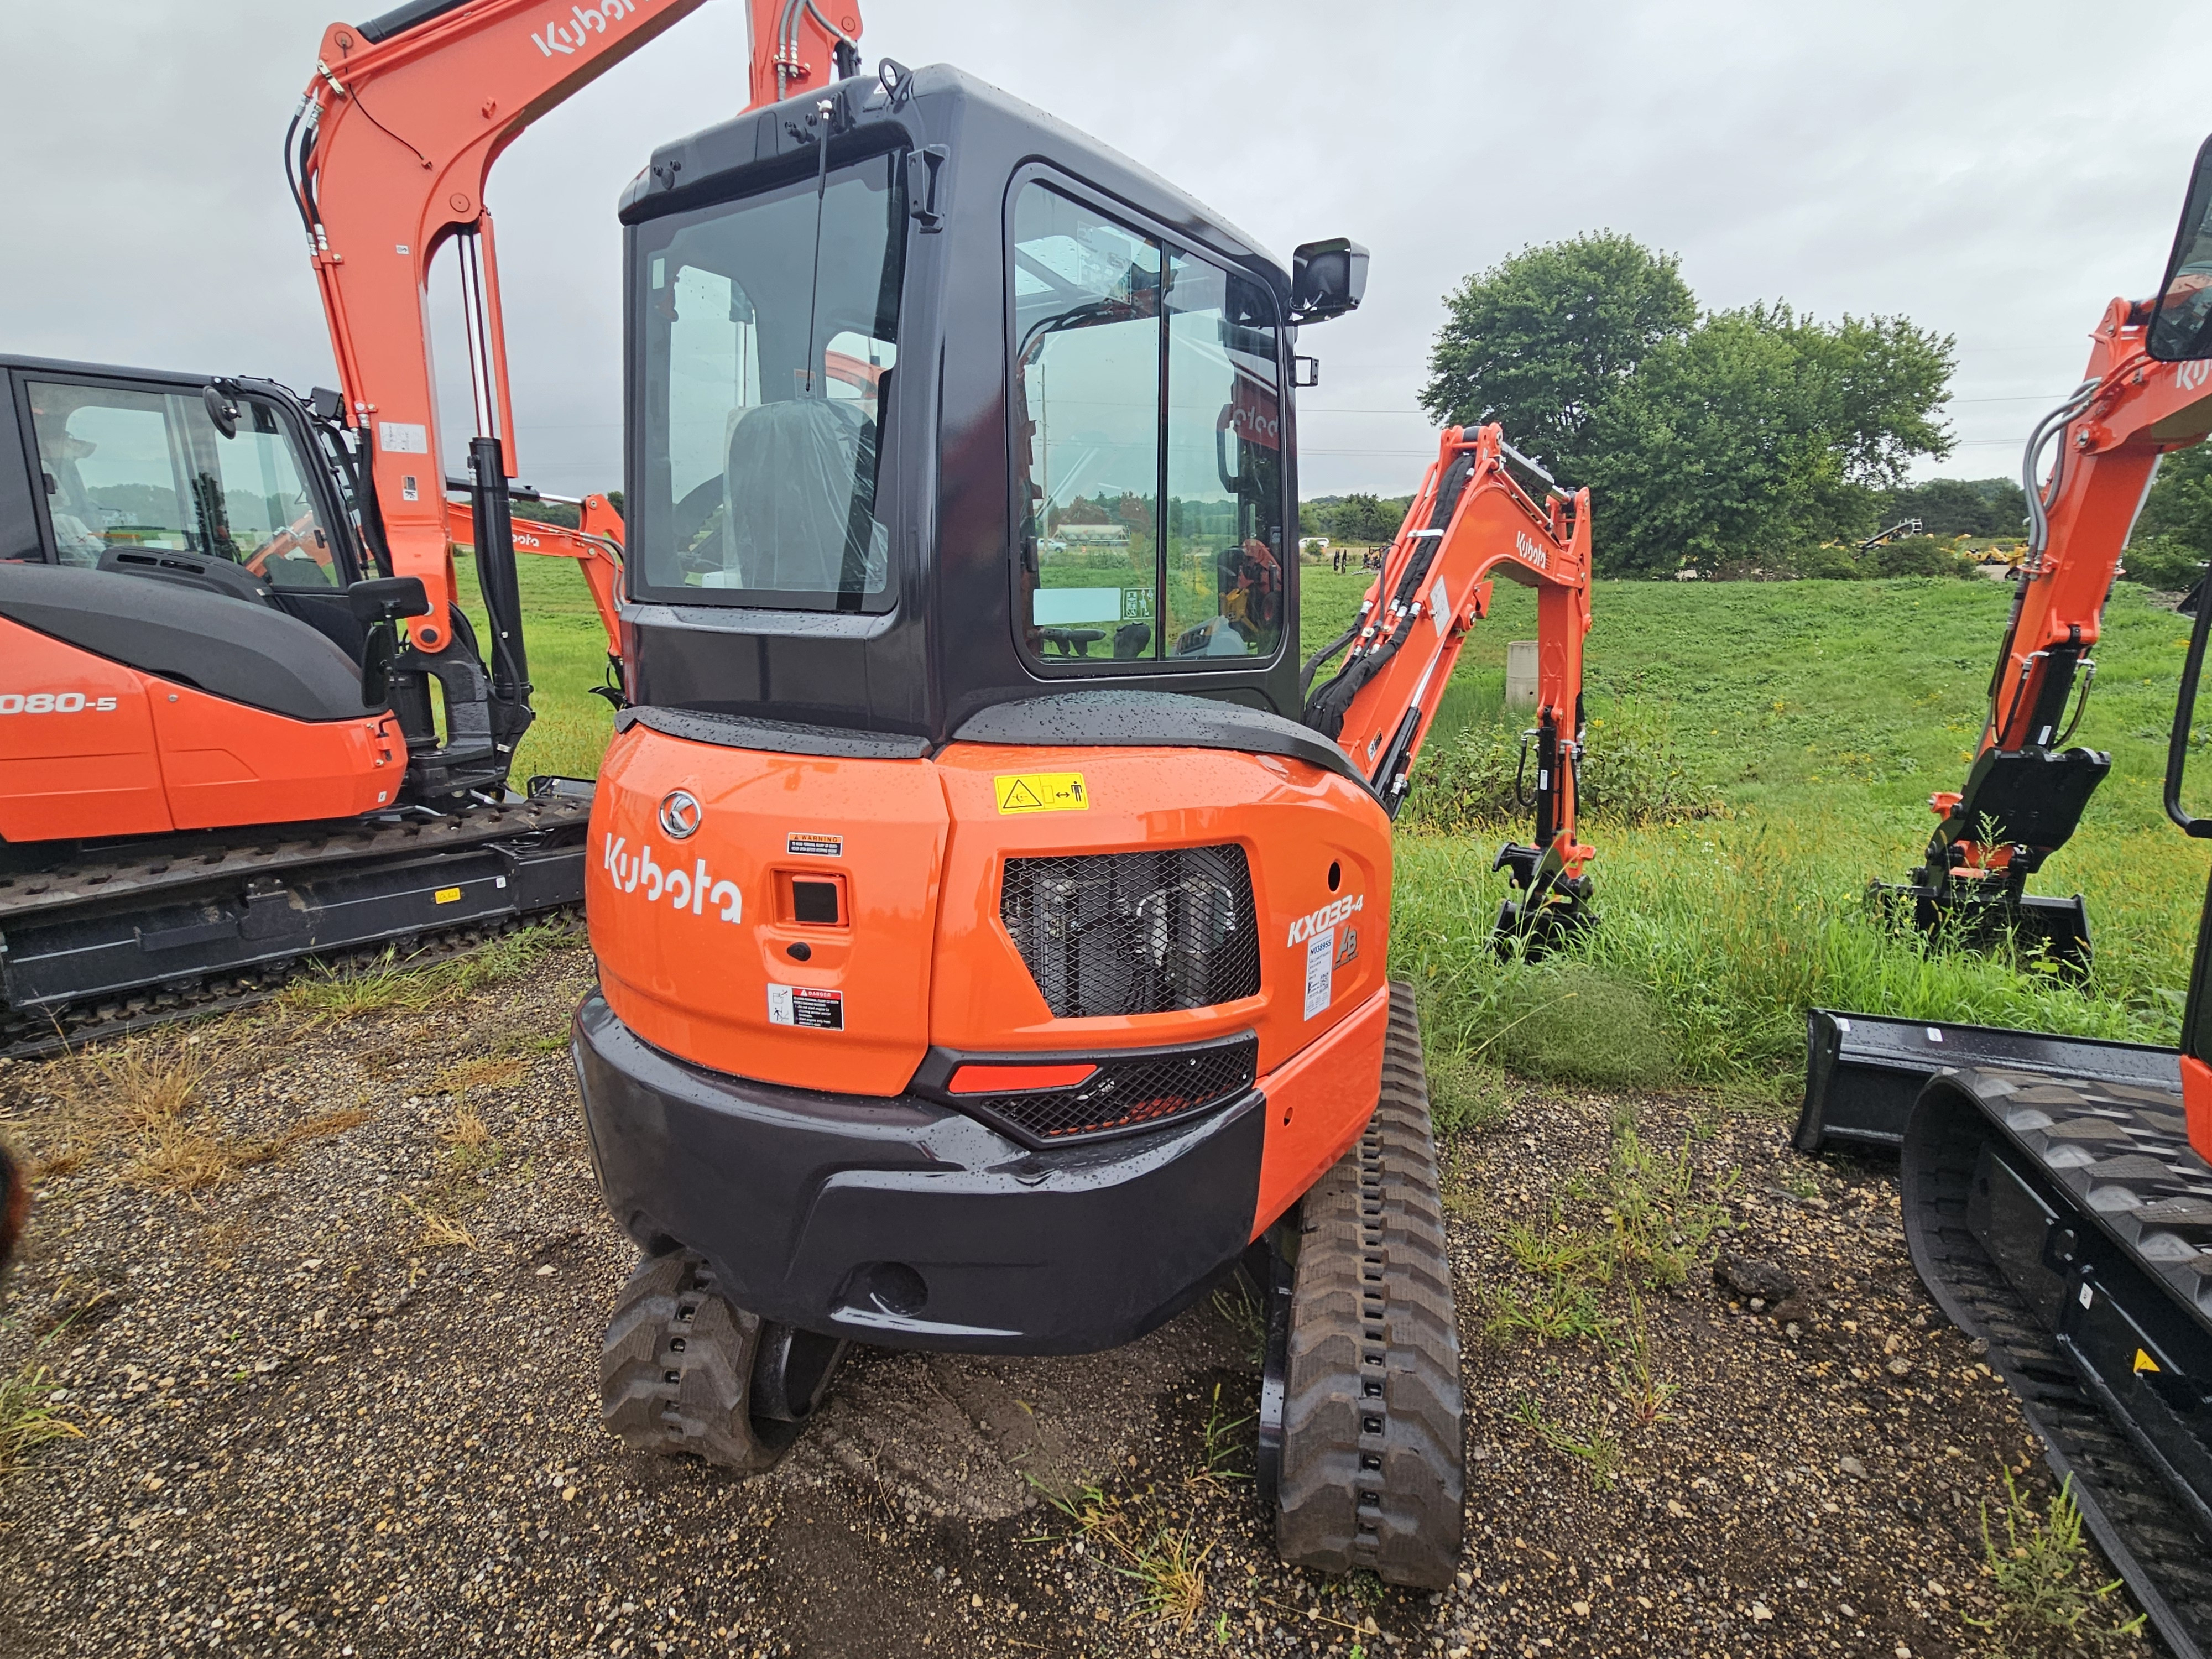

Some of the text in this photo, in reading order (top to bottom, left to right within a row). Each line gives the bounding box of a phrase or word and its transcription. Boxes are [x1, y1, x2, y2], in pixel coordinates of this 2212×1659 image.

[1516, 530, 1546, 570] Kubota
[604, 832, 742, 924] Kubota
[1287, 894, 1363, 948] KX033-4
